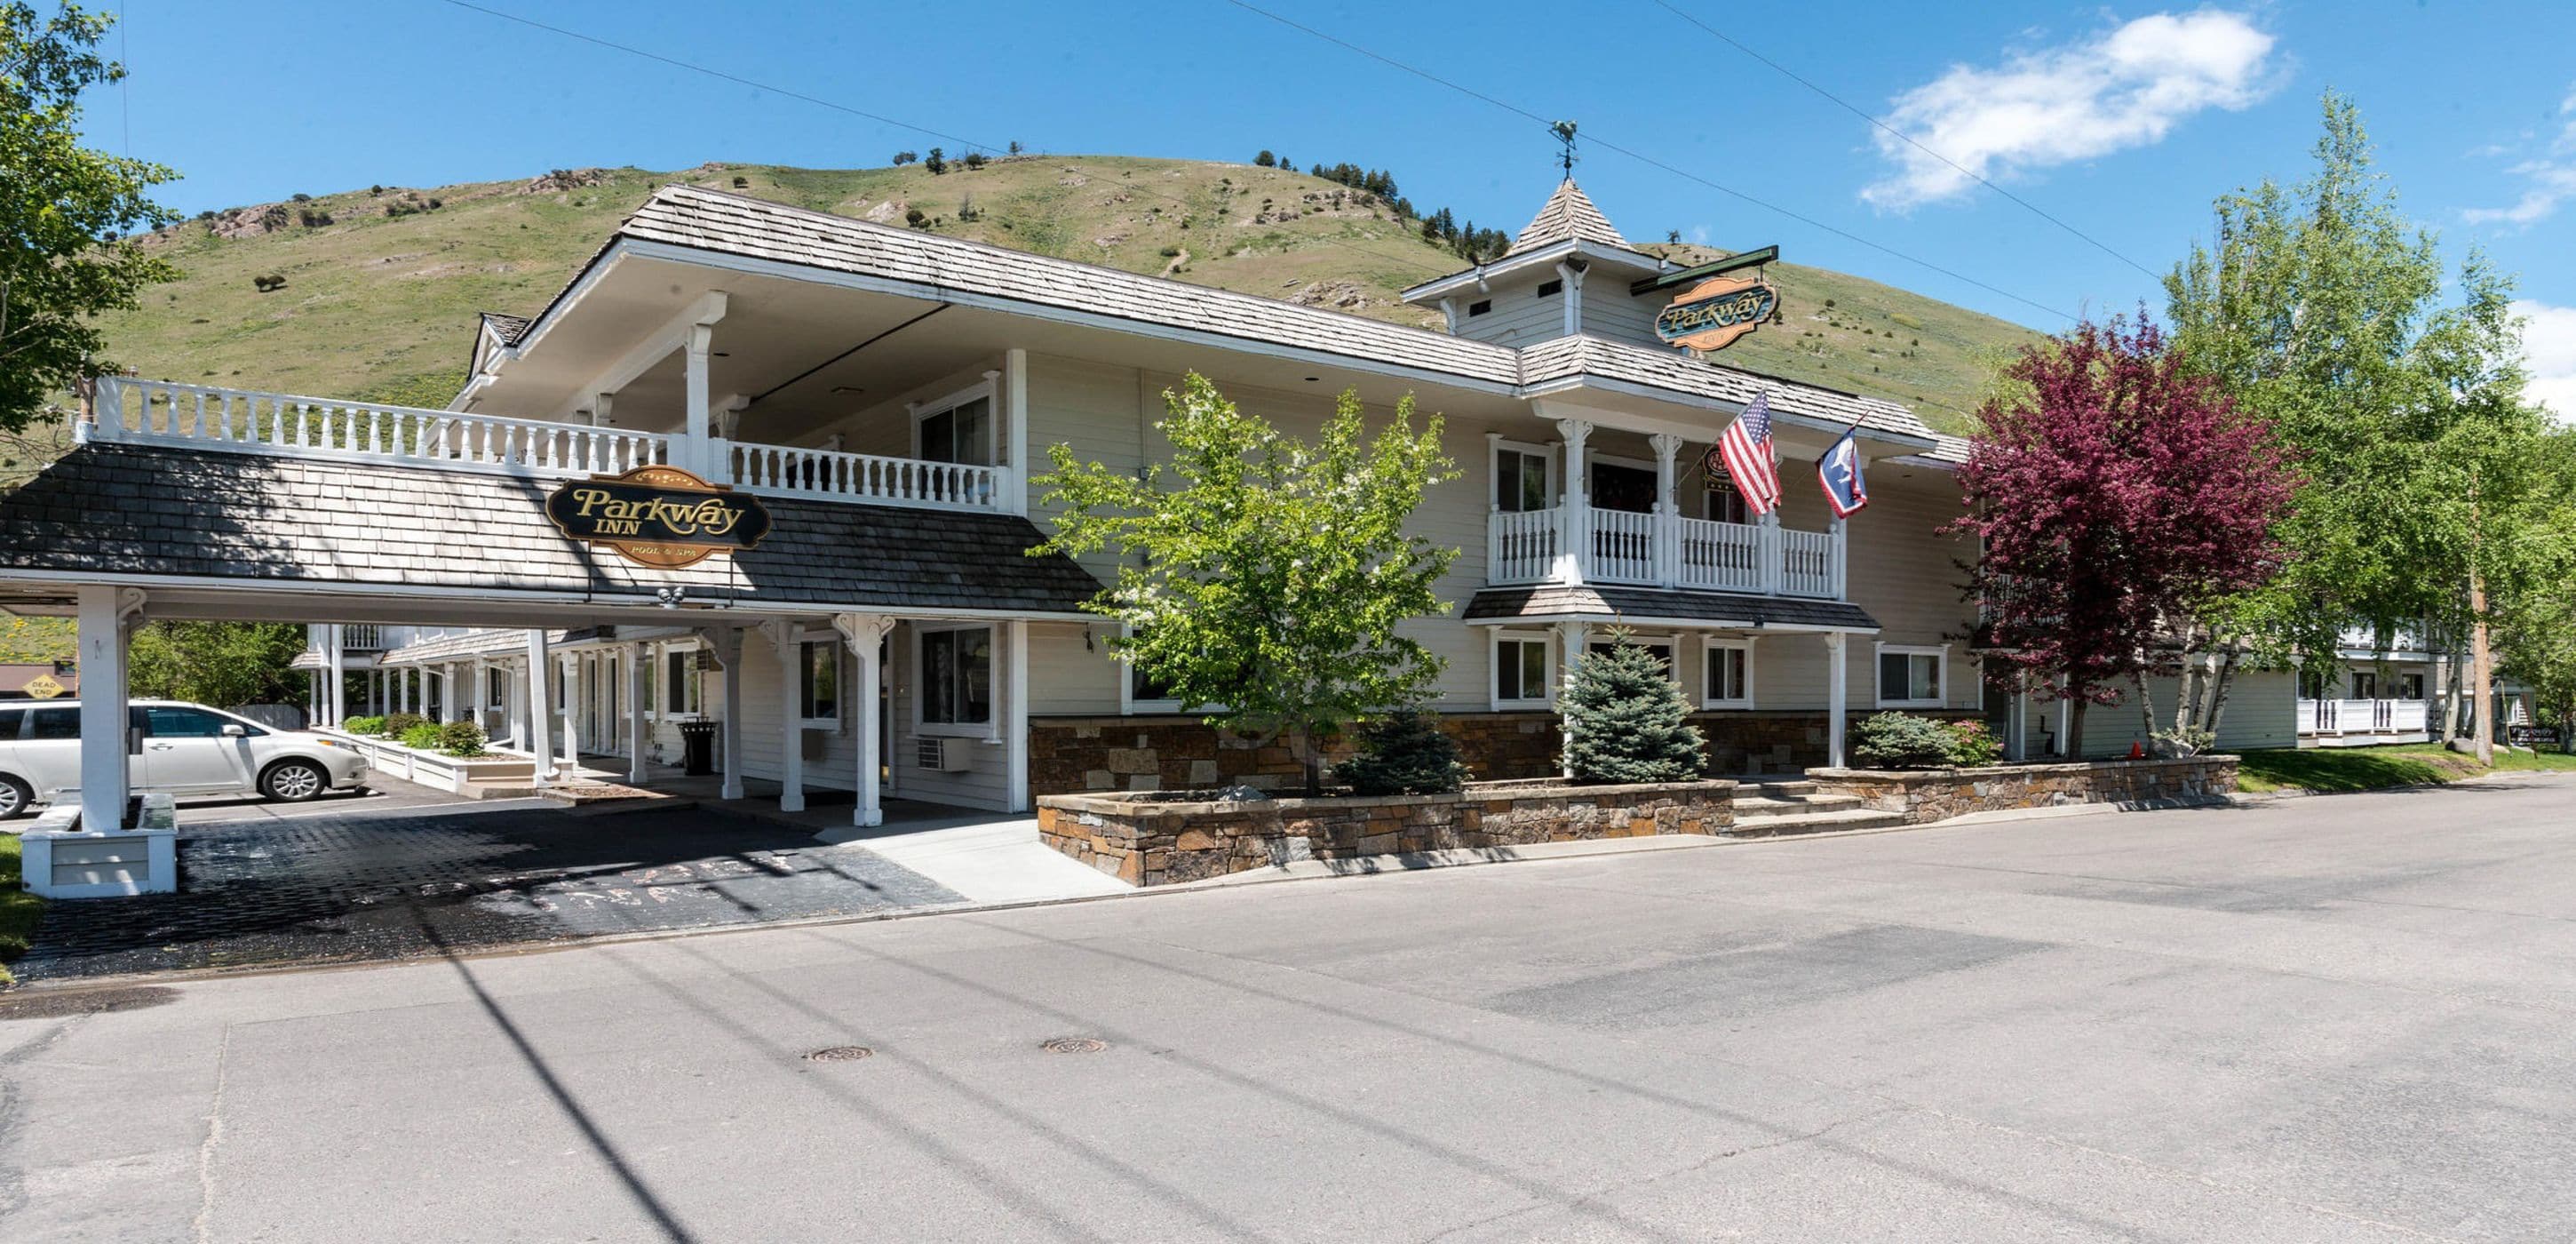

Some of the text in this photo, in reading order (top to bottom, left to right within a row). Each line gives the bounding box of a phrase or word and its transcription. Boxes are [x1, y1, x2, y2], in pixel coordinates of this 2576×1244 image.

[1666, 291, 1765, 330] Parkway
[573, 489, 745, 535] Parkway
[592, 519, 642, 535] INN
[632, 546, 659, 554] POOL
